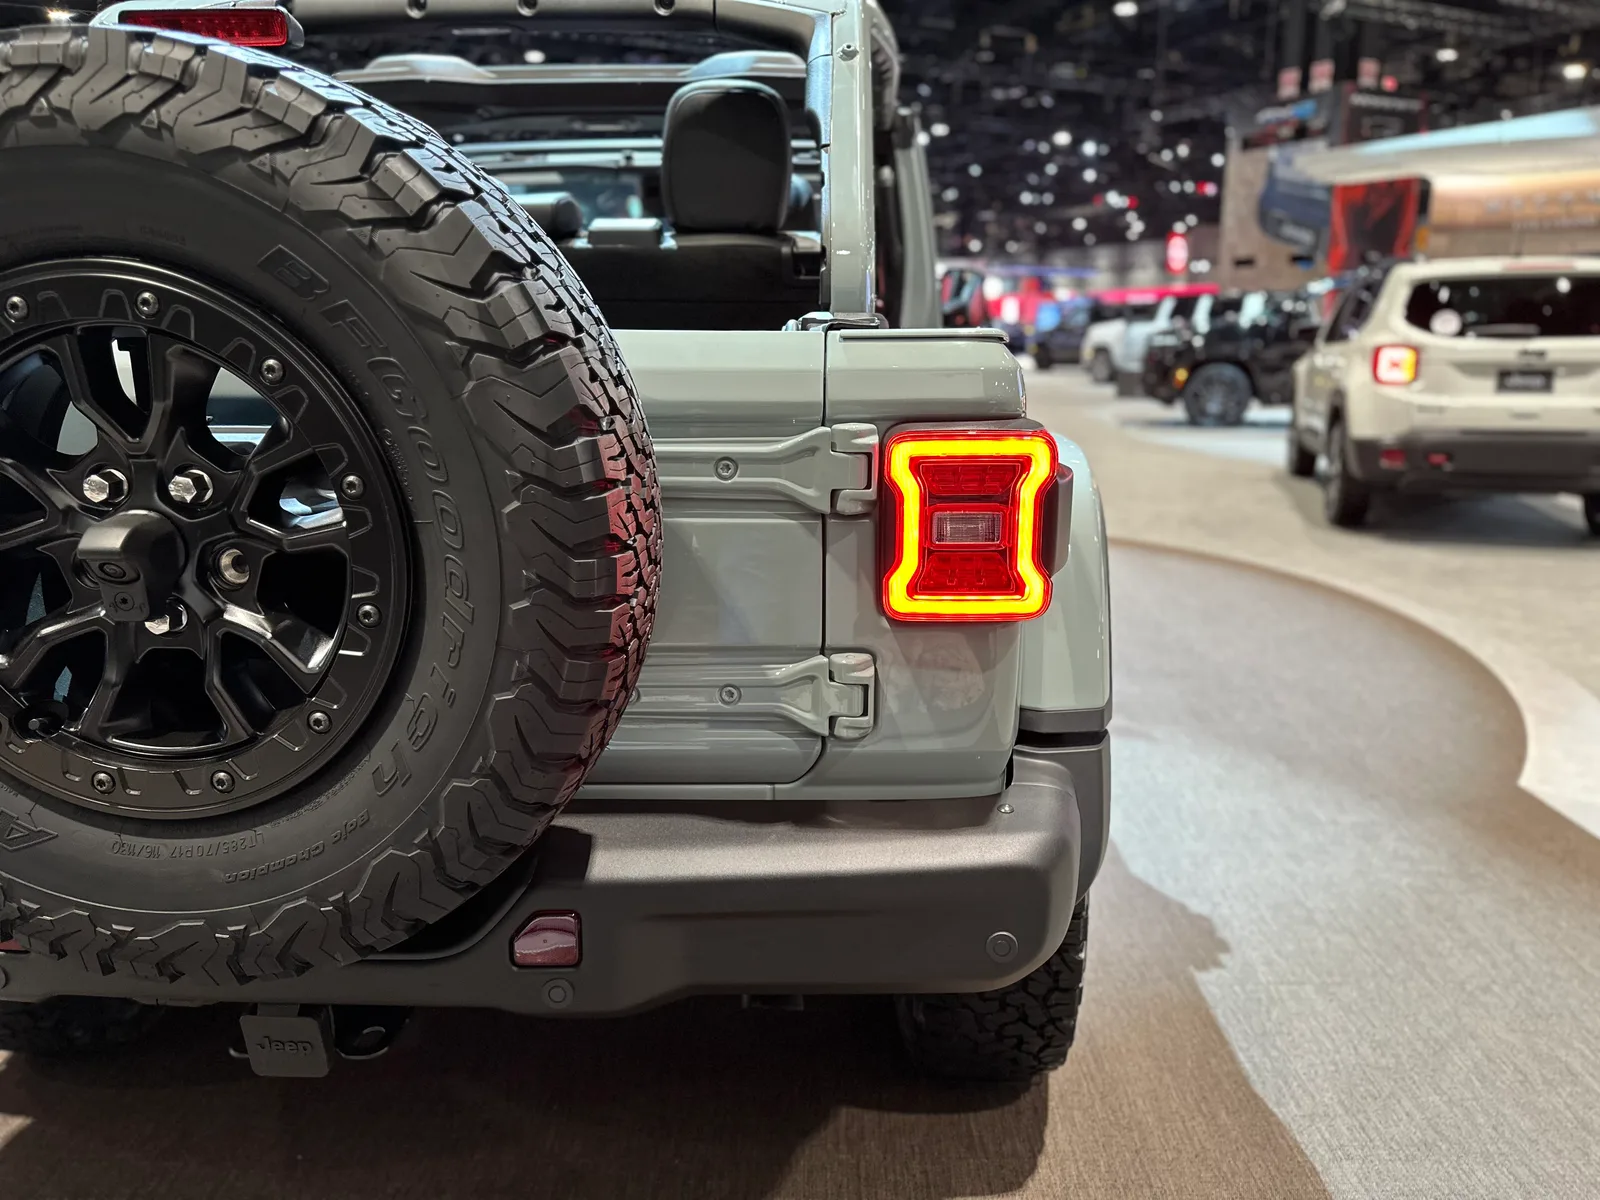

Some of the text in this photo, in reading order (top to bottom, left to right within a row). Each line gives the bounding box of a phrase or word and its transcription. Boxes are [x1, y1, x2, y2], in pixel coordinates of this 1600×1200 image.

[257, 245, 474, 796] BFGoodrich
[224, 808, 370, 884] Baja Champion
[256, 1035, 313, 1057] Jeep
